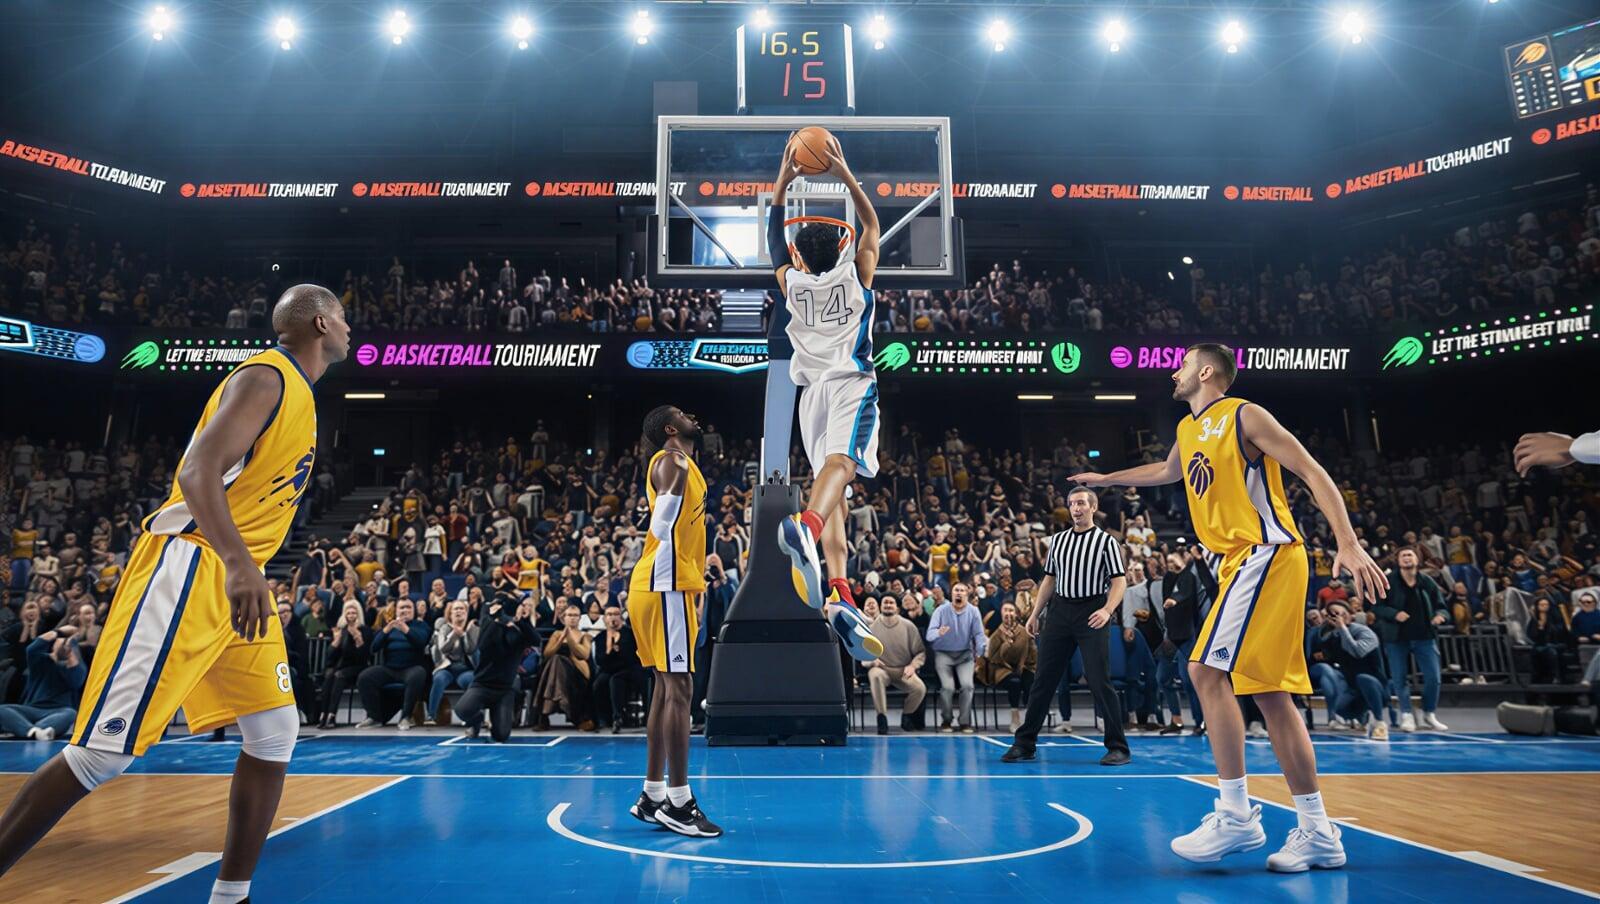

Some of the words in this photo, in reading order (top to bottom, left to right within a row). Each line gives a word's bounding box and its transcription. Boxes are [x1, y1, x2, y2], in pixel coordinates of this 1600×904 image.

[761, 31, 818, 56] 16.5
[783, 61, 826, 99] 15
[795, 284, 853, 327] 14
[381, 343, 493, 367] BASKETBALL
[1198, 414, 1227, 441] 34
